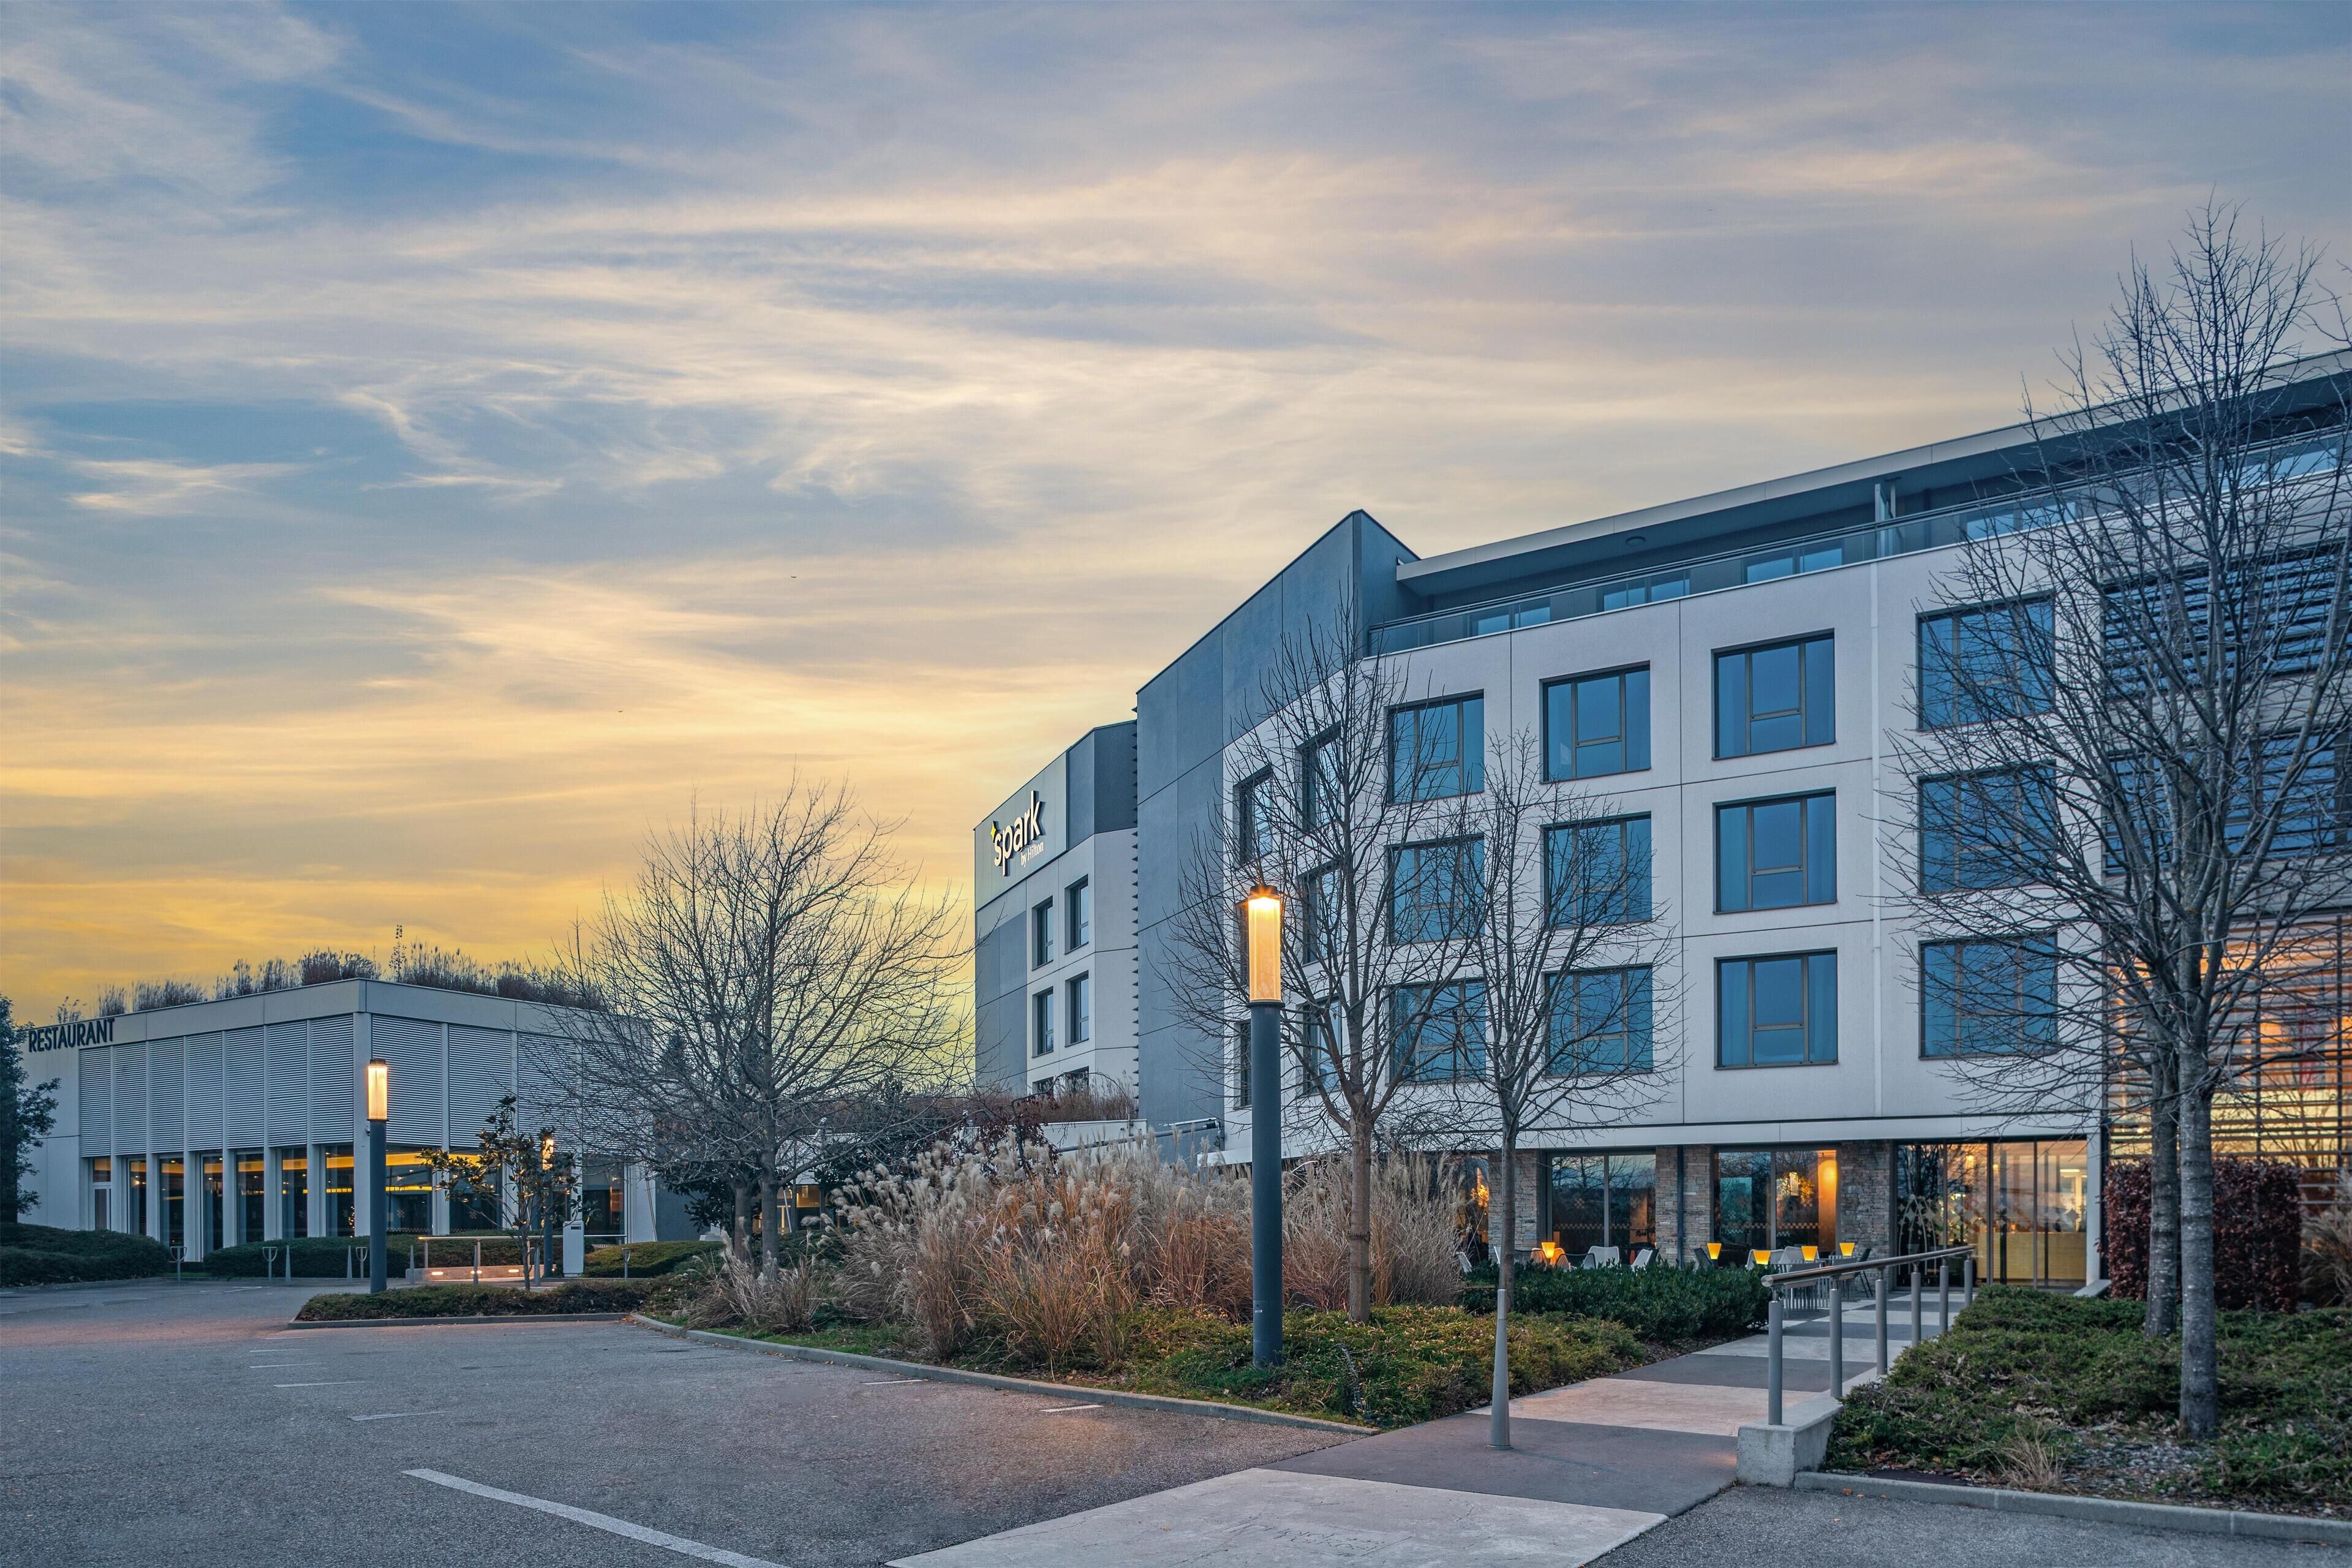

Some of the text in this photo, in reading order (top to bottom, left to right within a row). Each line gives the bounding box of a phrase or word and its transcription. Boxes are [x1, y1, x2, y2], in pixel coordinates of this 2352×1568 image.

[994, 790, 1041, 876] spark
[1020, 842, 1044, 867] by Hilton
[29, 1018, 115, 1052] RESTAURANT
